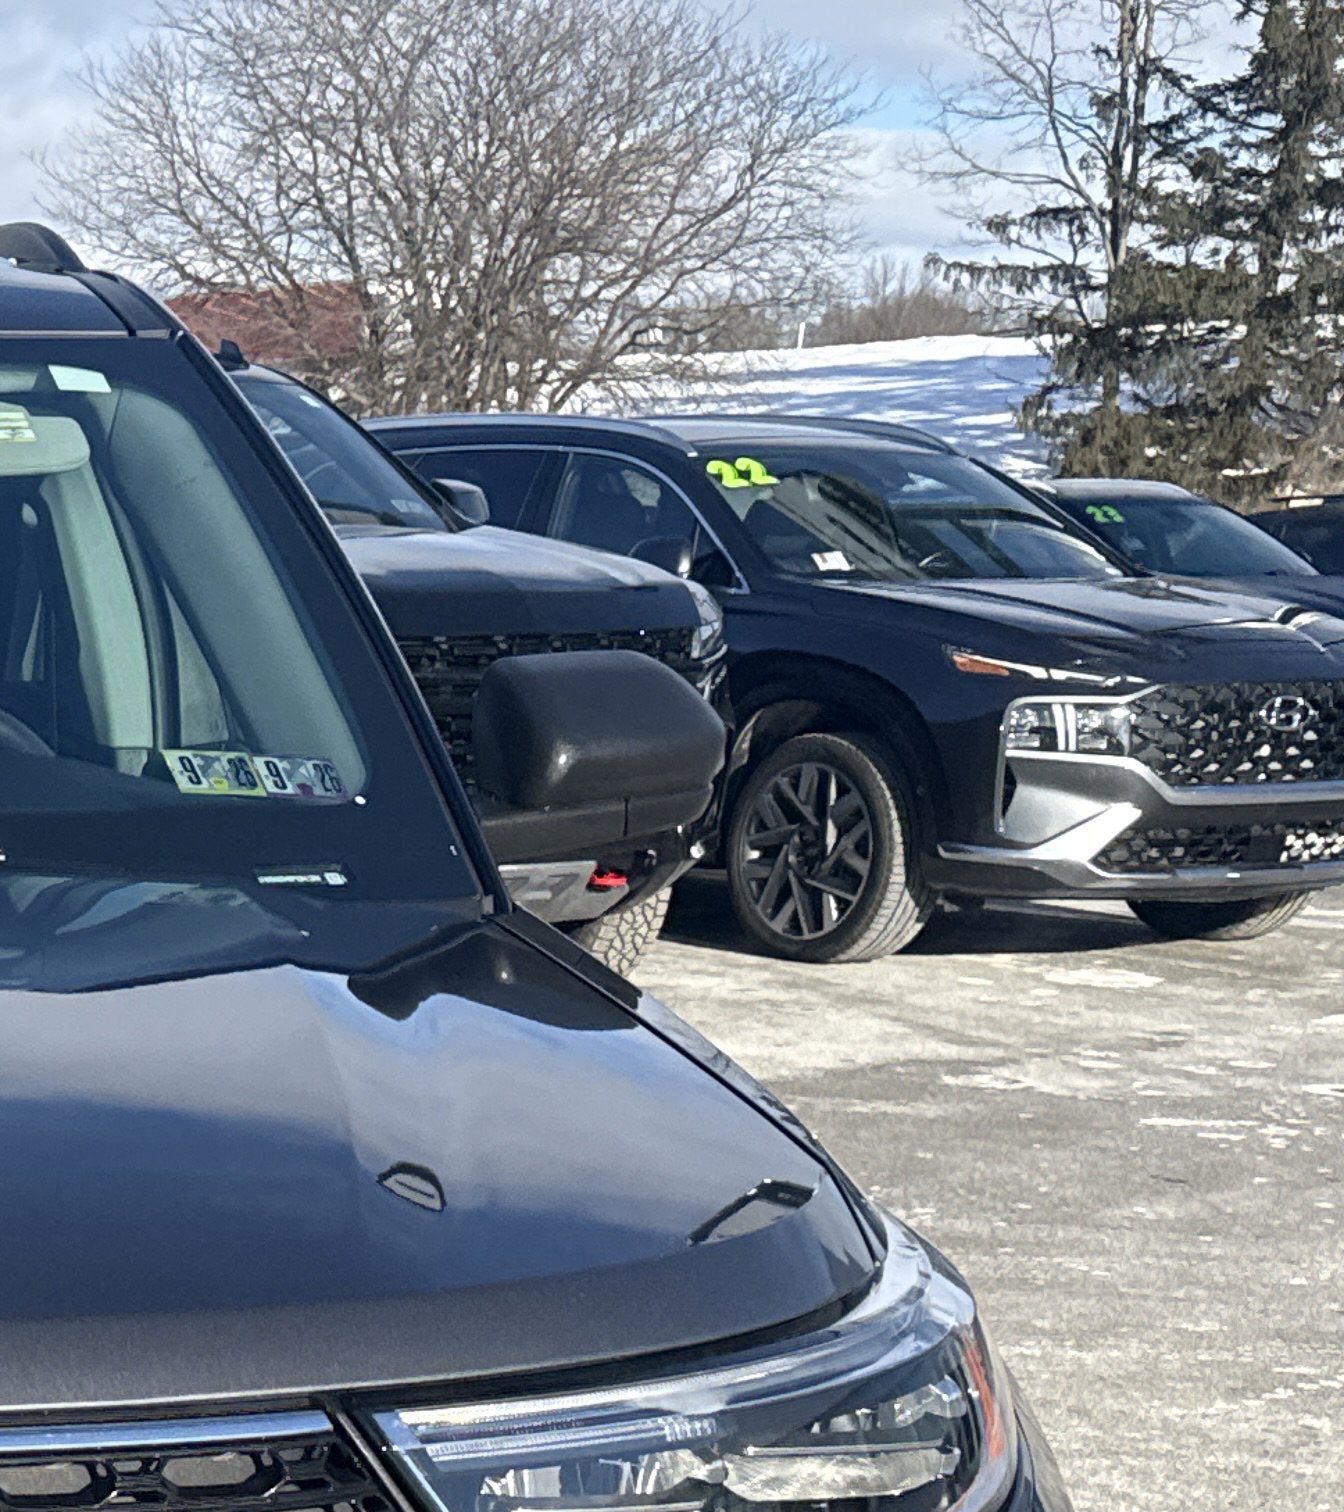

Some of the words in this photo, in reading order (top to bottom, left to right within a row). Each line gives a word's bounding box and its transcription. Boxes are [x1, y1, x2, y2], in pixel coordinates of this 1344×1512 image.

[706, 457, 781, 488] 22
[1085, 505, 1125, 523] 23
[178, 755, 203, 785] 9
[226, 755, 259, 788] 26
[264, 760, 288, 790] 9
[311, 762, 343, 793] 26
